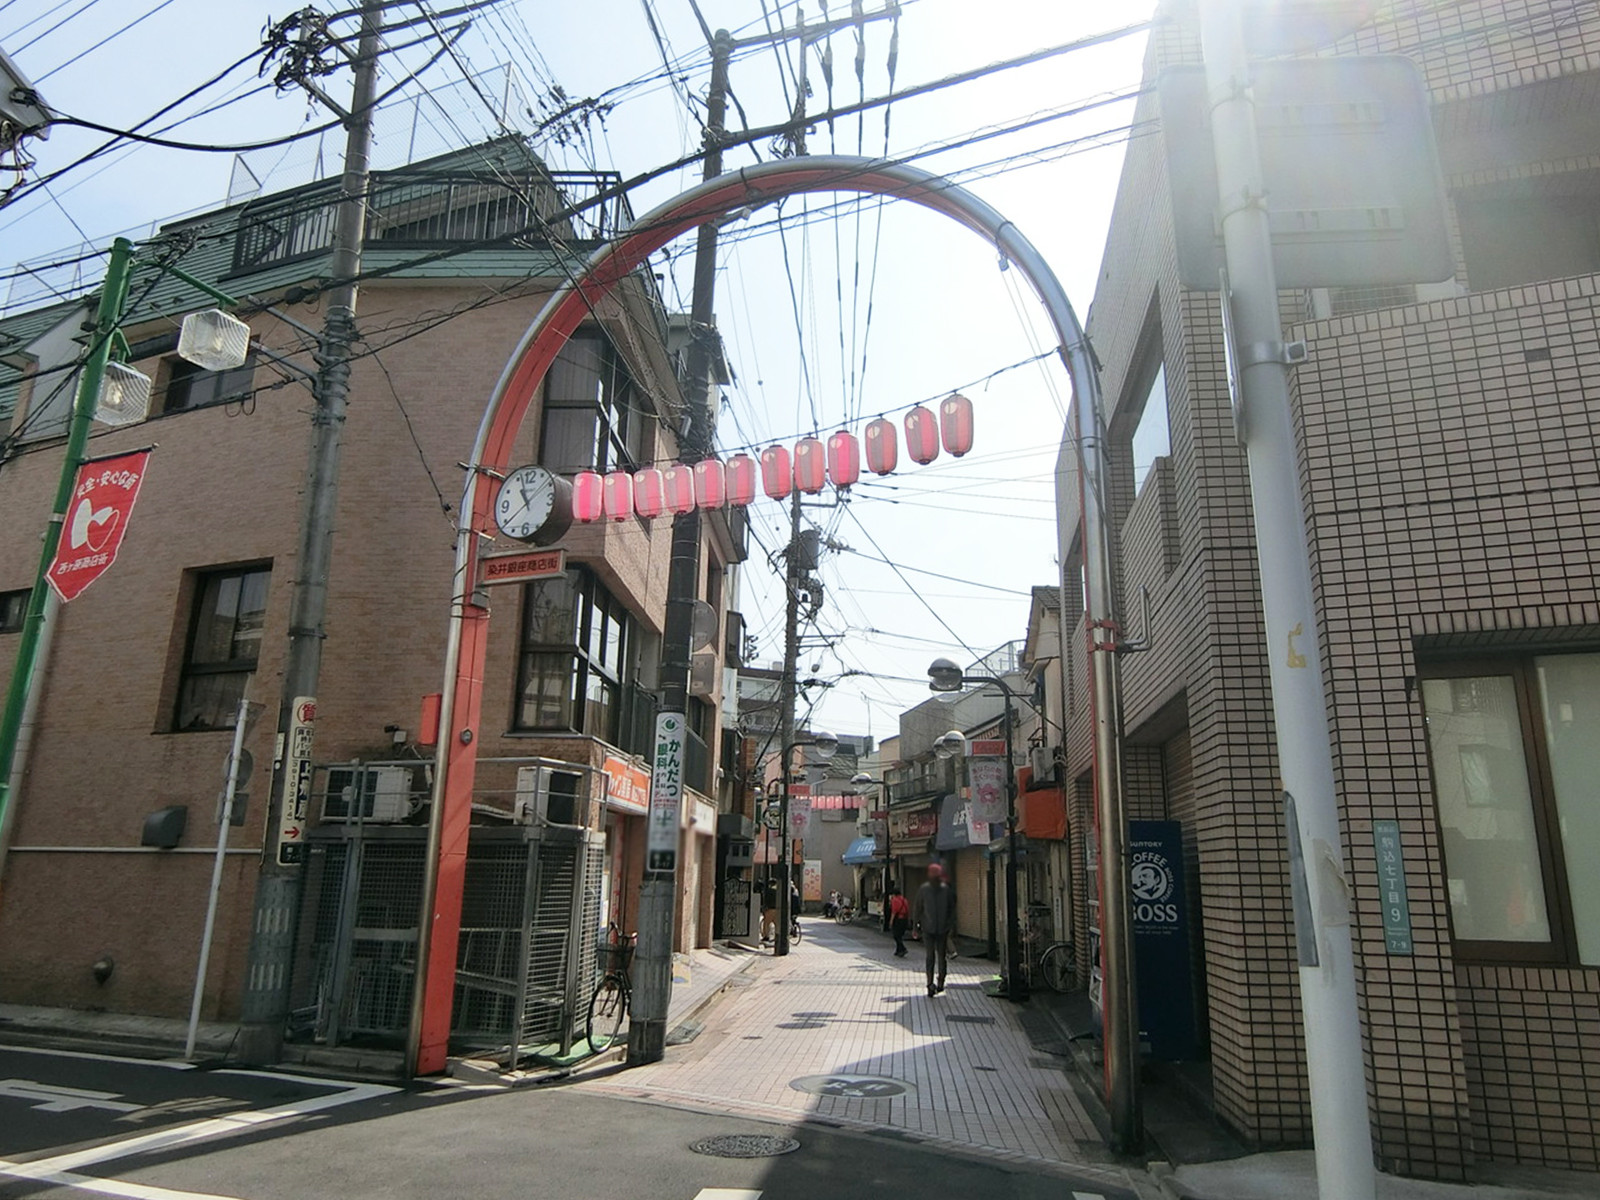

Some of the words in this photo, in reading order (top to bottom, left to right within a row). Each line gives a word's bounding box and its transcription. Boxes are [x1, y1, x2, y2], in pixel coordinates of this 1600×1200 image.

[525, 470, 536, 484] 12
[501, 500, 509, 514] 9
[546, 492, 555, 506] 3
[521, 522, 530, 536] 6
[487, 557, 558, 575] 染井銀座商店街
[302, 704, 317, 722] 質
[656, 743, 668, 769] 眼科
[667, 739, 681, 796] かんだつ
